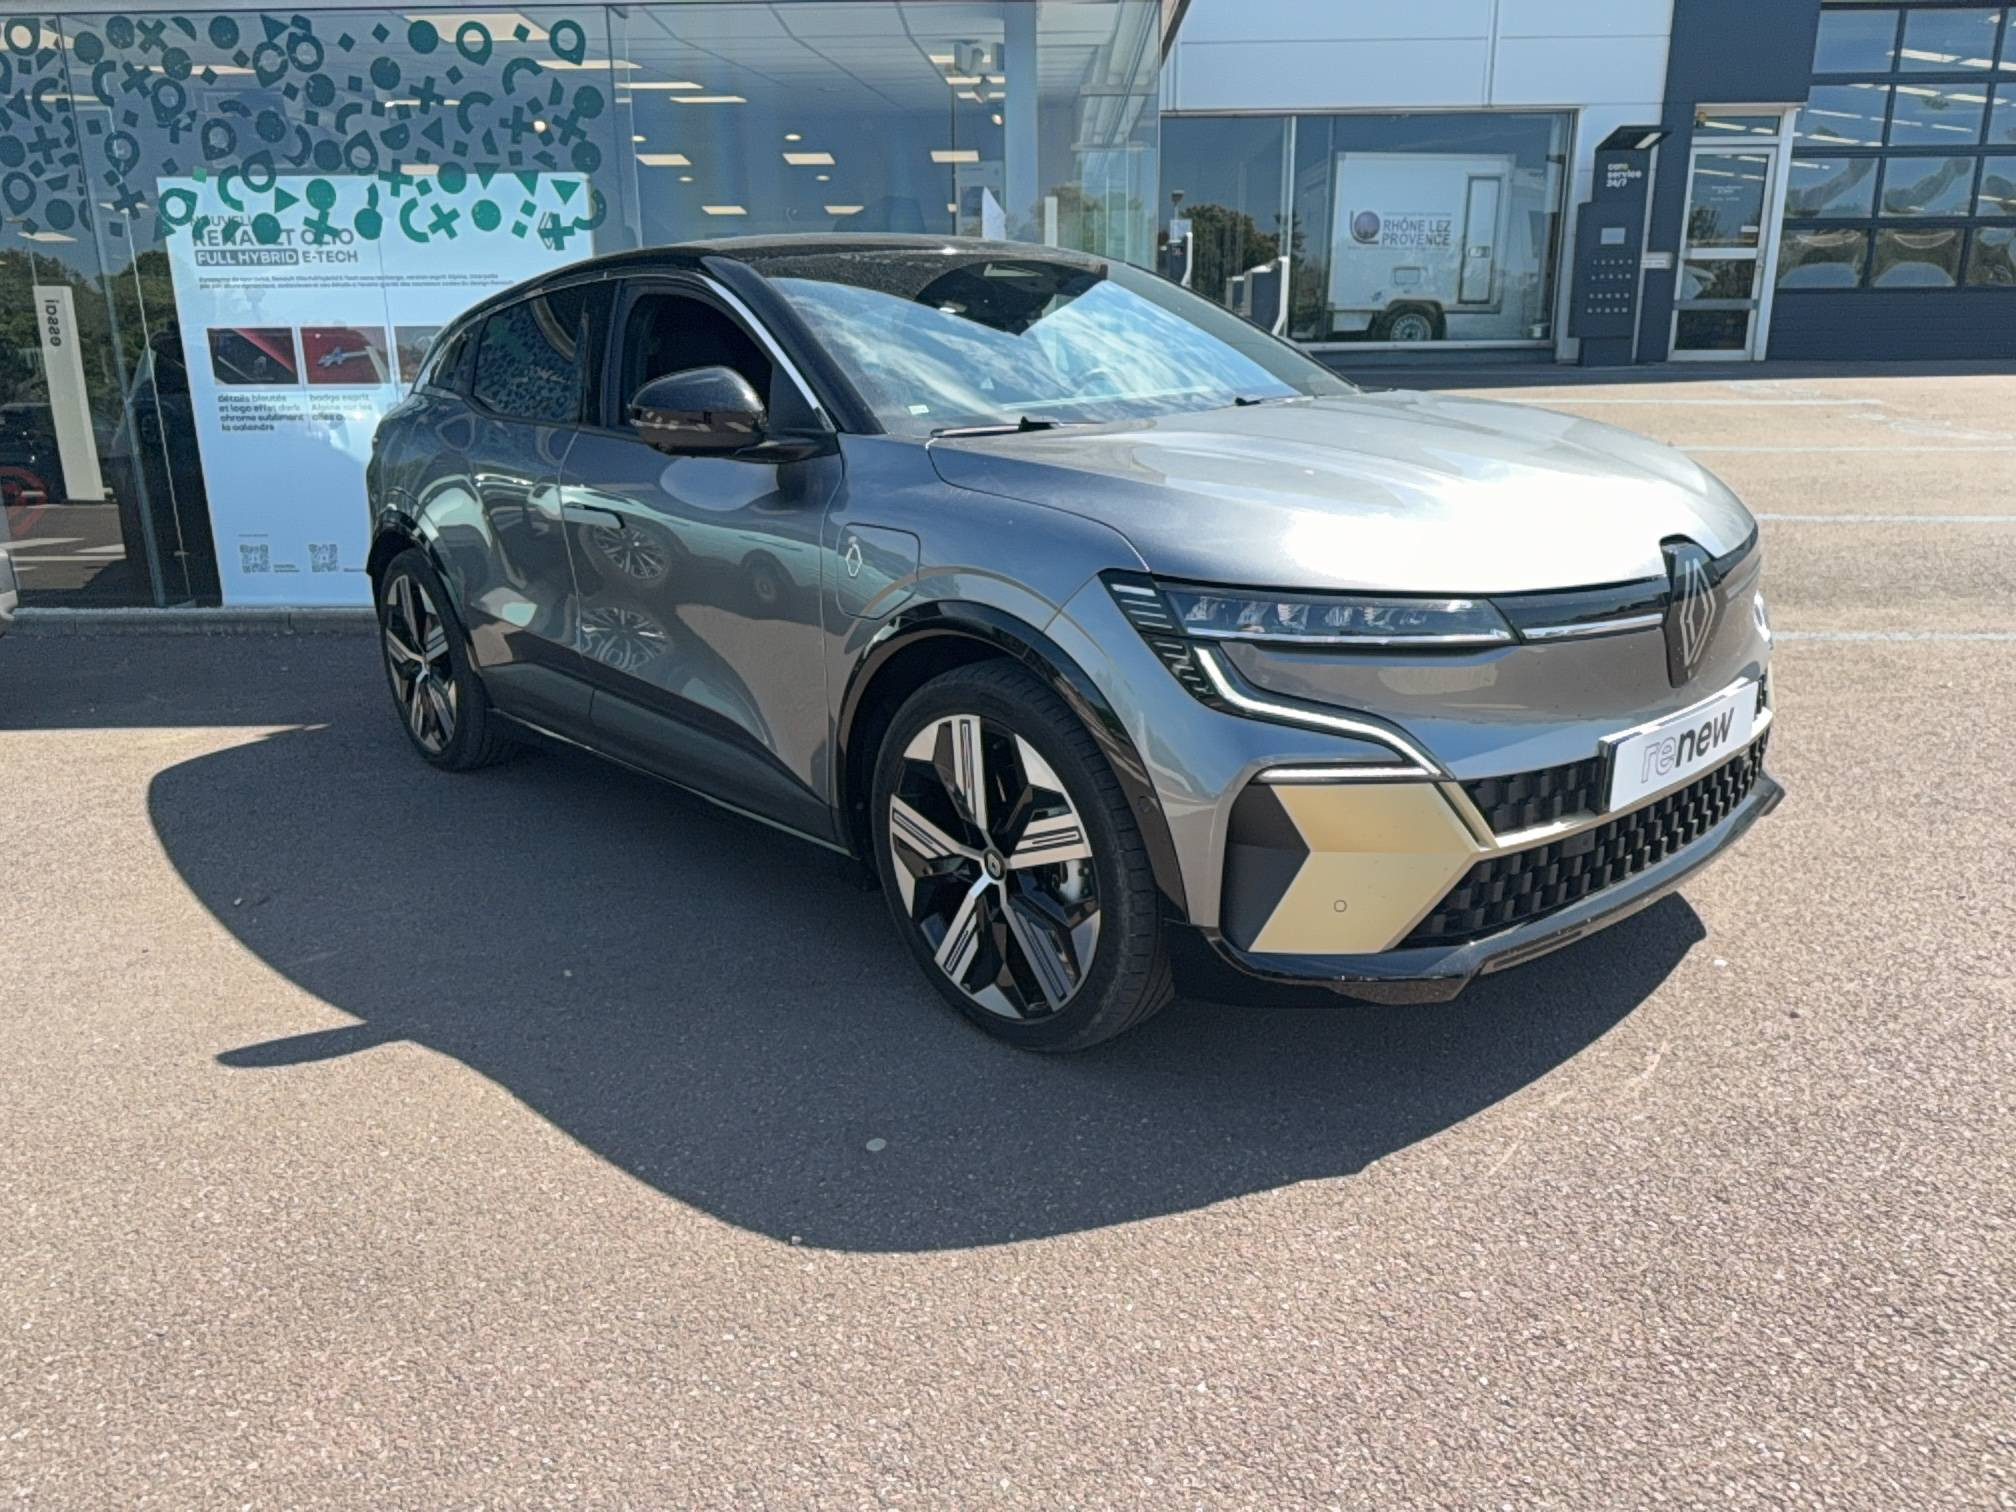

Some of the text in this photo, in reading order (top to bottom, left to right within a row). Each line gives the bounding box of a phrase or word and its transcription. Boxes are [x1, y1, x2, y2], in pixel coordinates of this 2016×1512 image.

[1606, 178, 1627, 188] 24/7
[1428, 219, 1452, 232] LEZ
[1382, 233, 1451, 246] PROVENCE
[197, 250, 359, 265] FULL HYBRID E-TECH
[230, 404, 252, 414] logo
[1641, 707, 1735, 784] renew
